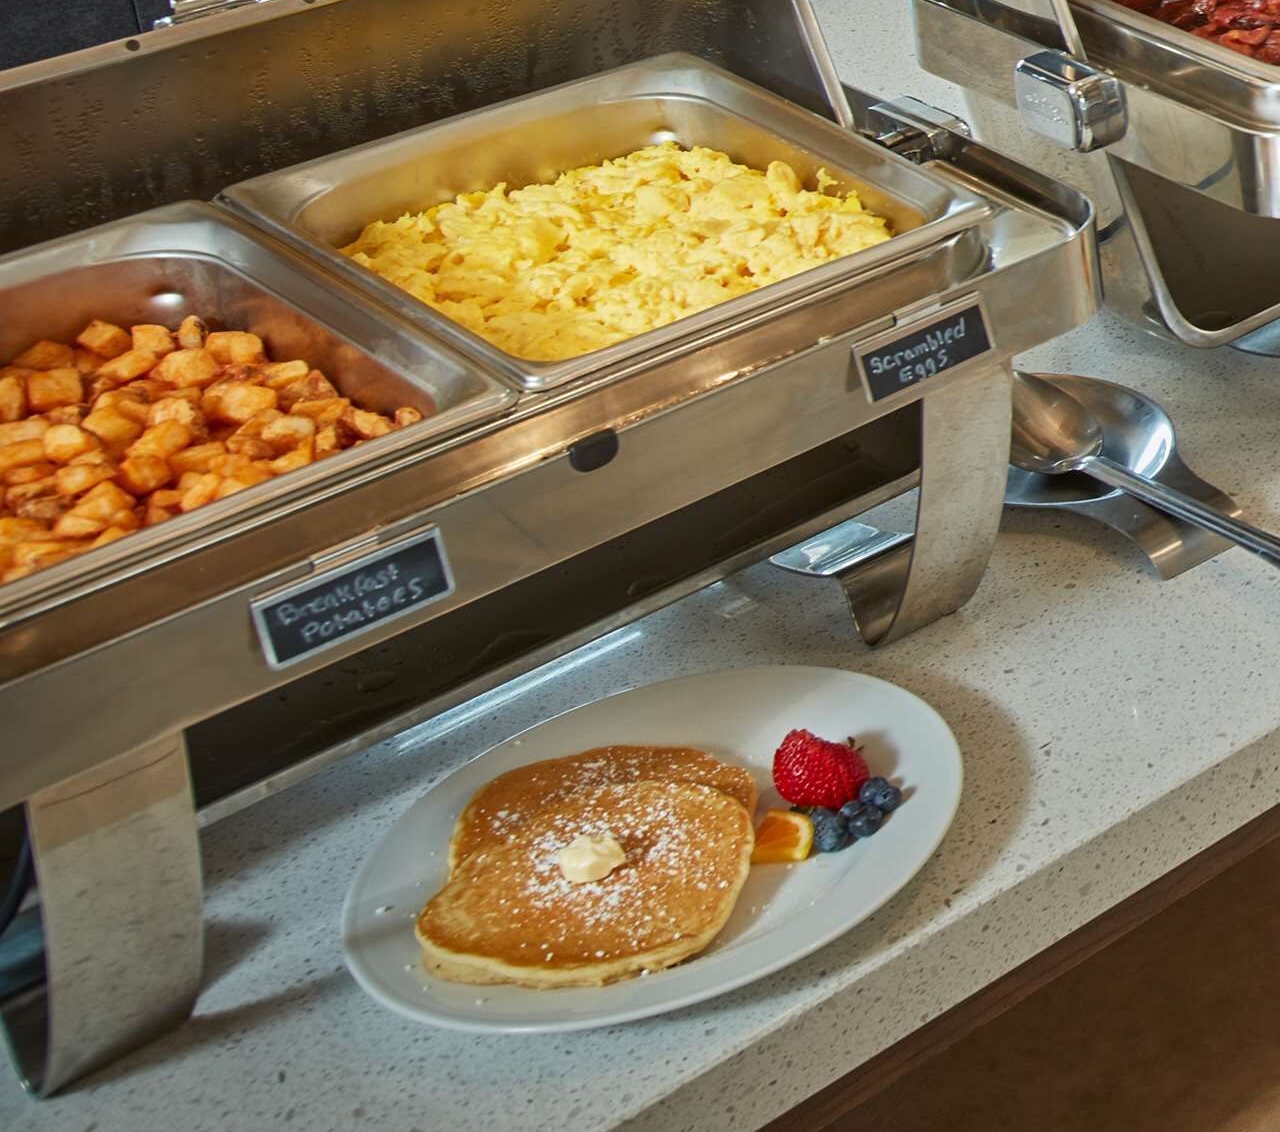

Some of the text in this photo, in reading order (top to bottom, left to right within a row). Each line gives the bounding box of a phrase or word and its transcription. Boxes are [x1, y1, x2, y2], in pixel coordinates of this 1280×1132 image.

[869, 316, 966, 374] Scrambled
[899, 348, 948, 383] Eggs
[276, 562, 399, 626] Breakfast
[301, 577, 425, 644] Potatoes
